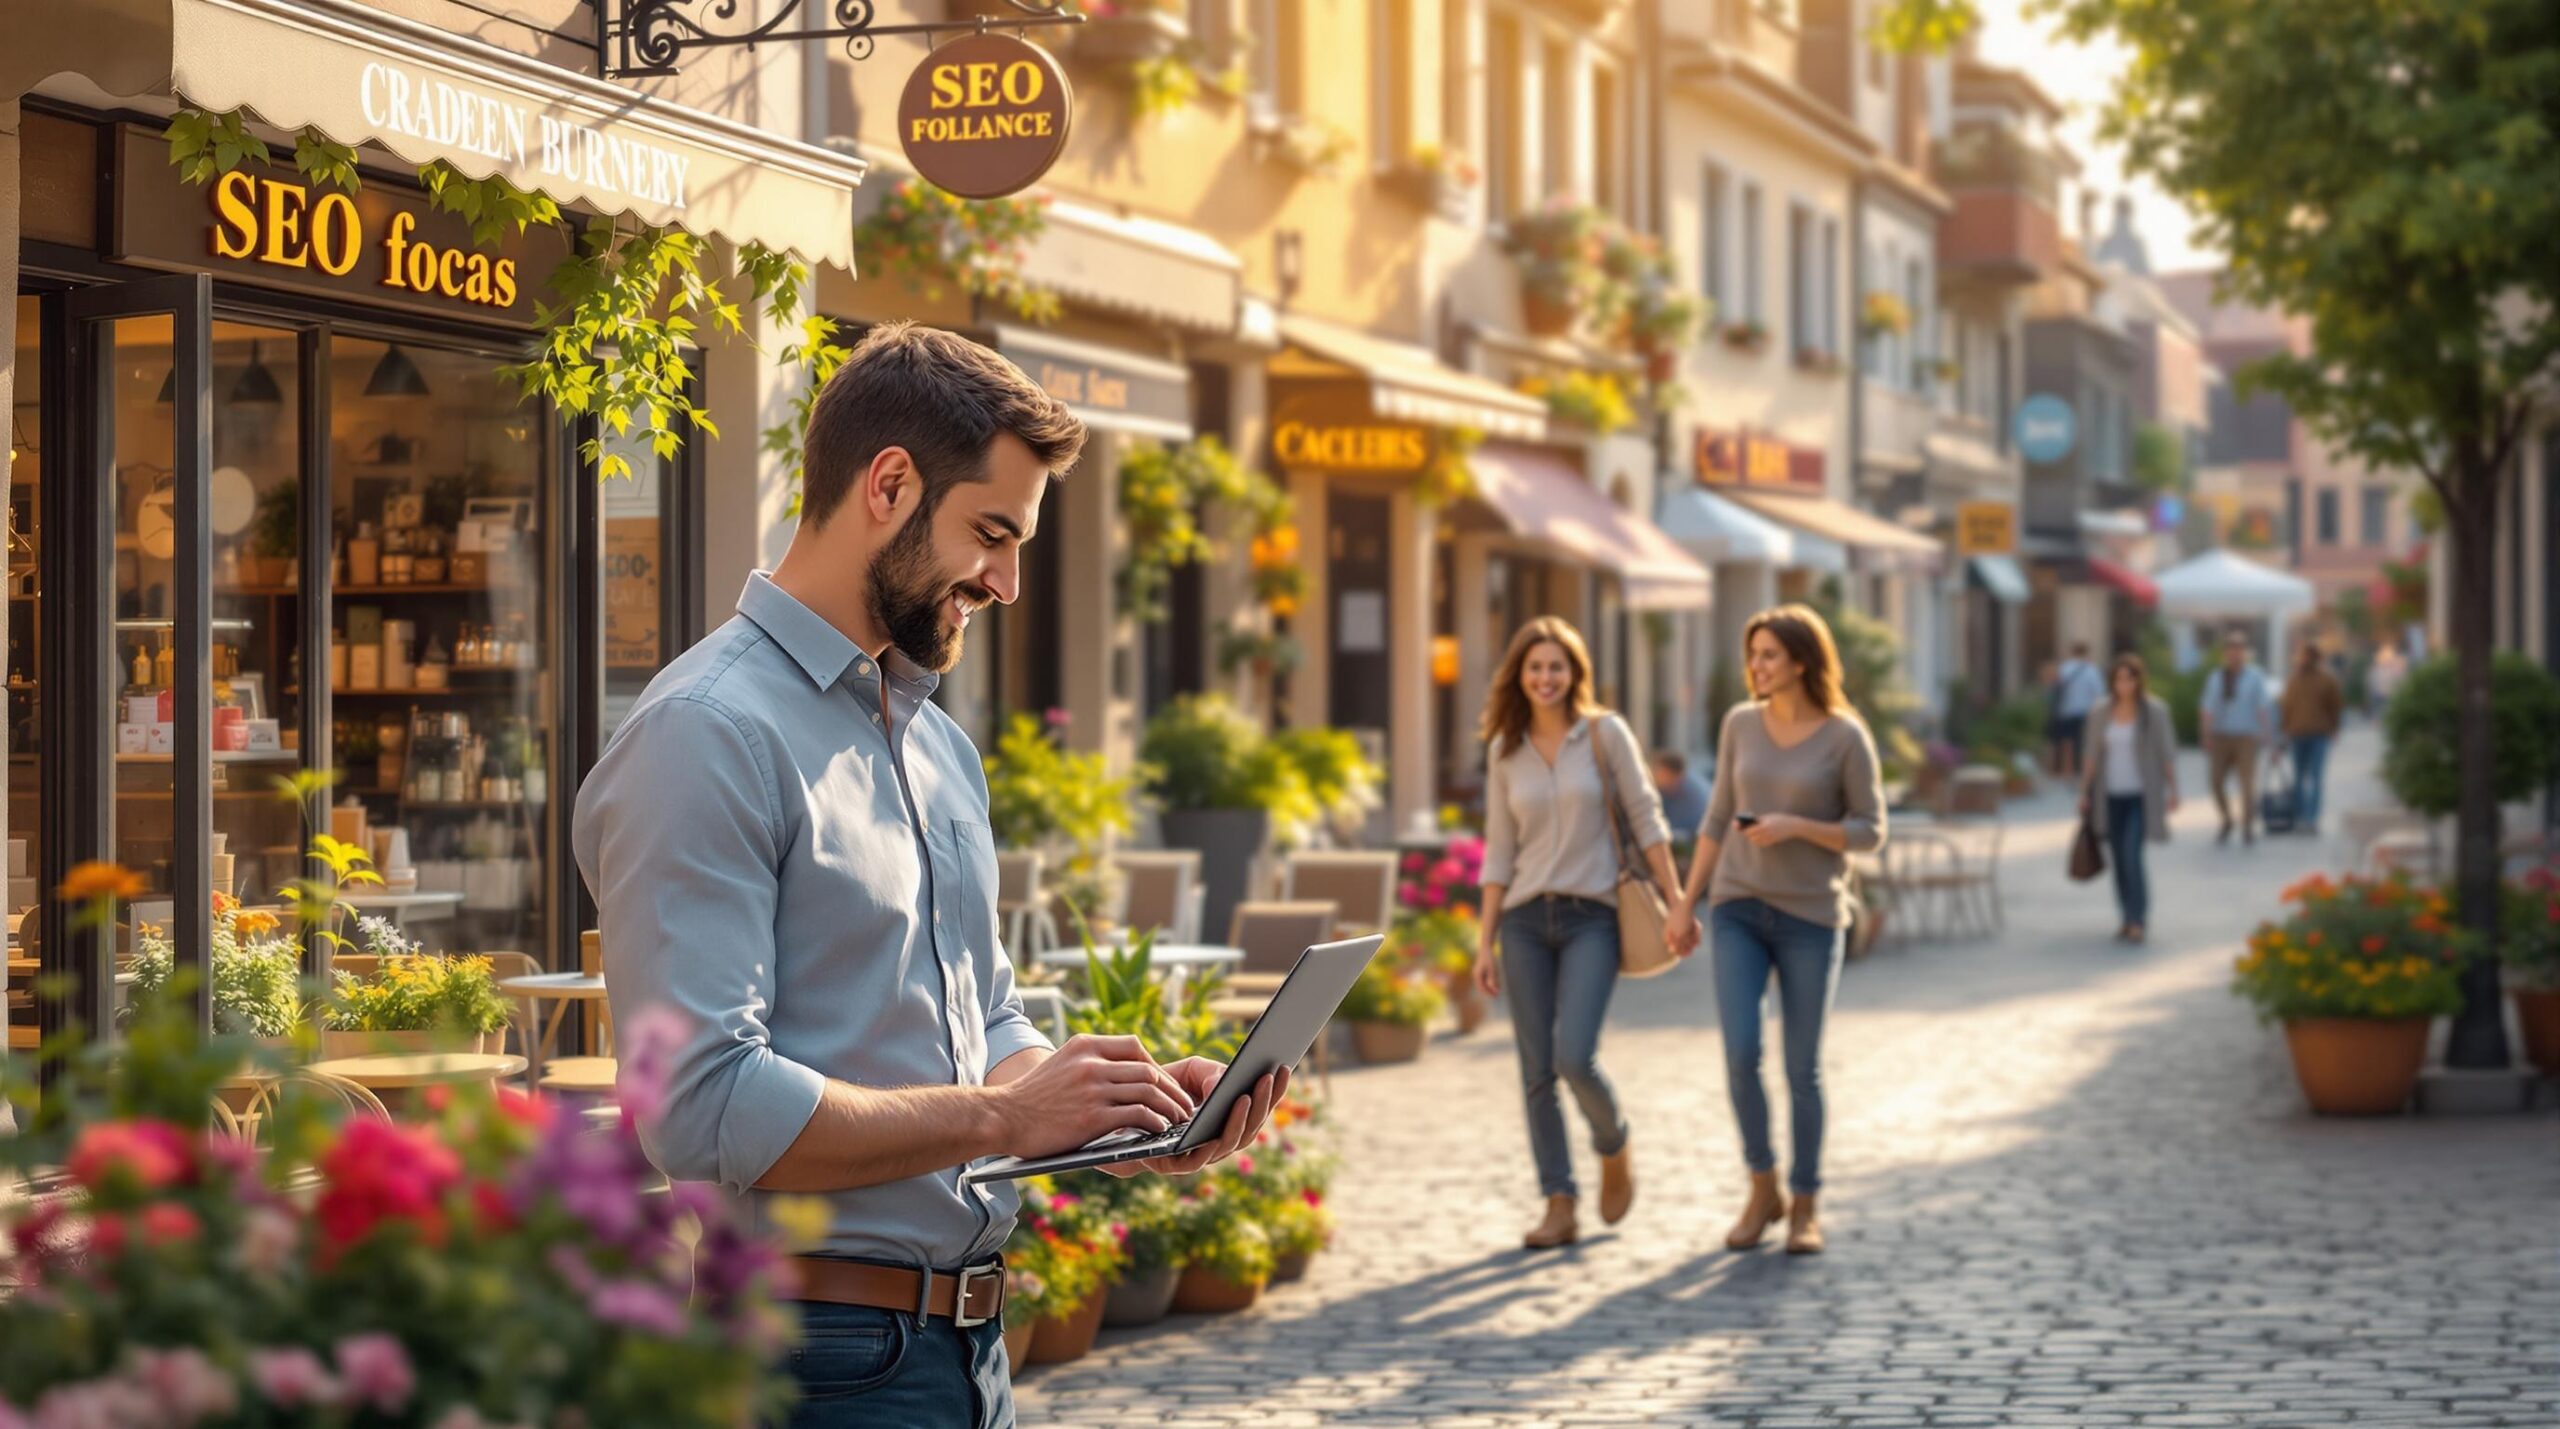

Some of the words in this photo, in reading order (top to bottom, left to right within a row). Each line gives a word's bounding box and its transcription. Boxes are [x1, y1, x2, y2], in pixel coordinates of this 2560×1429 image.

[911, 111, 1052, 142] FOLLANCE
[931, 60, 1044, 109] SEO
[360, 62, 527, 171] CRADEEN
[539, 114, 691, 209] BURNERY
[213, 170, 362, 277] SEO
[382, 211, 518, 308] focas
